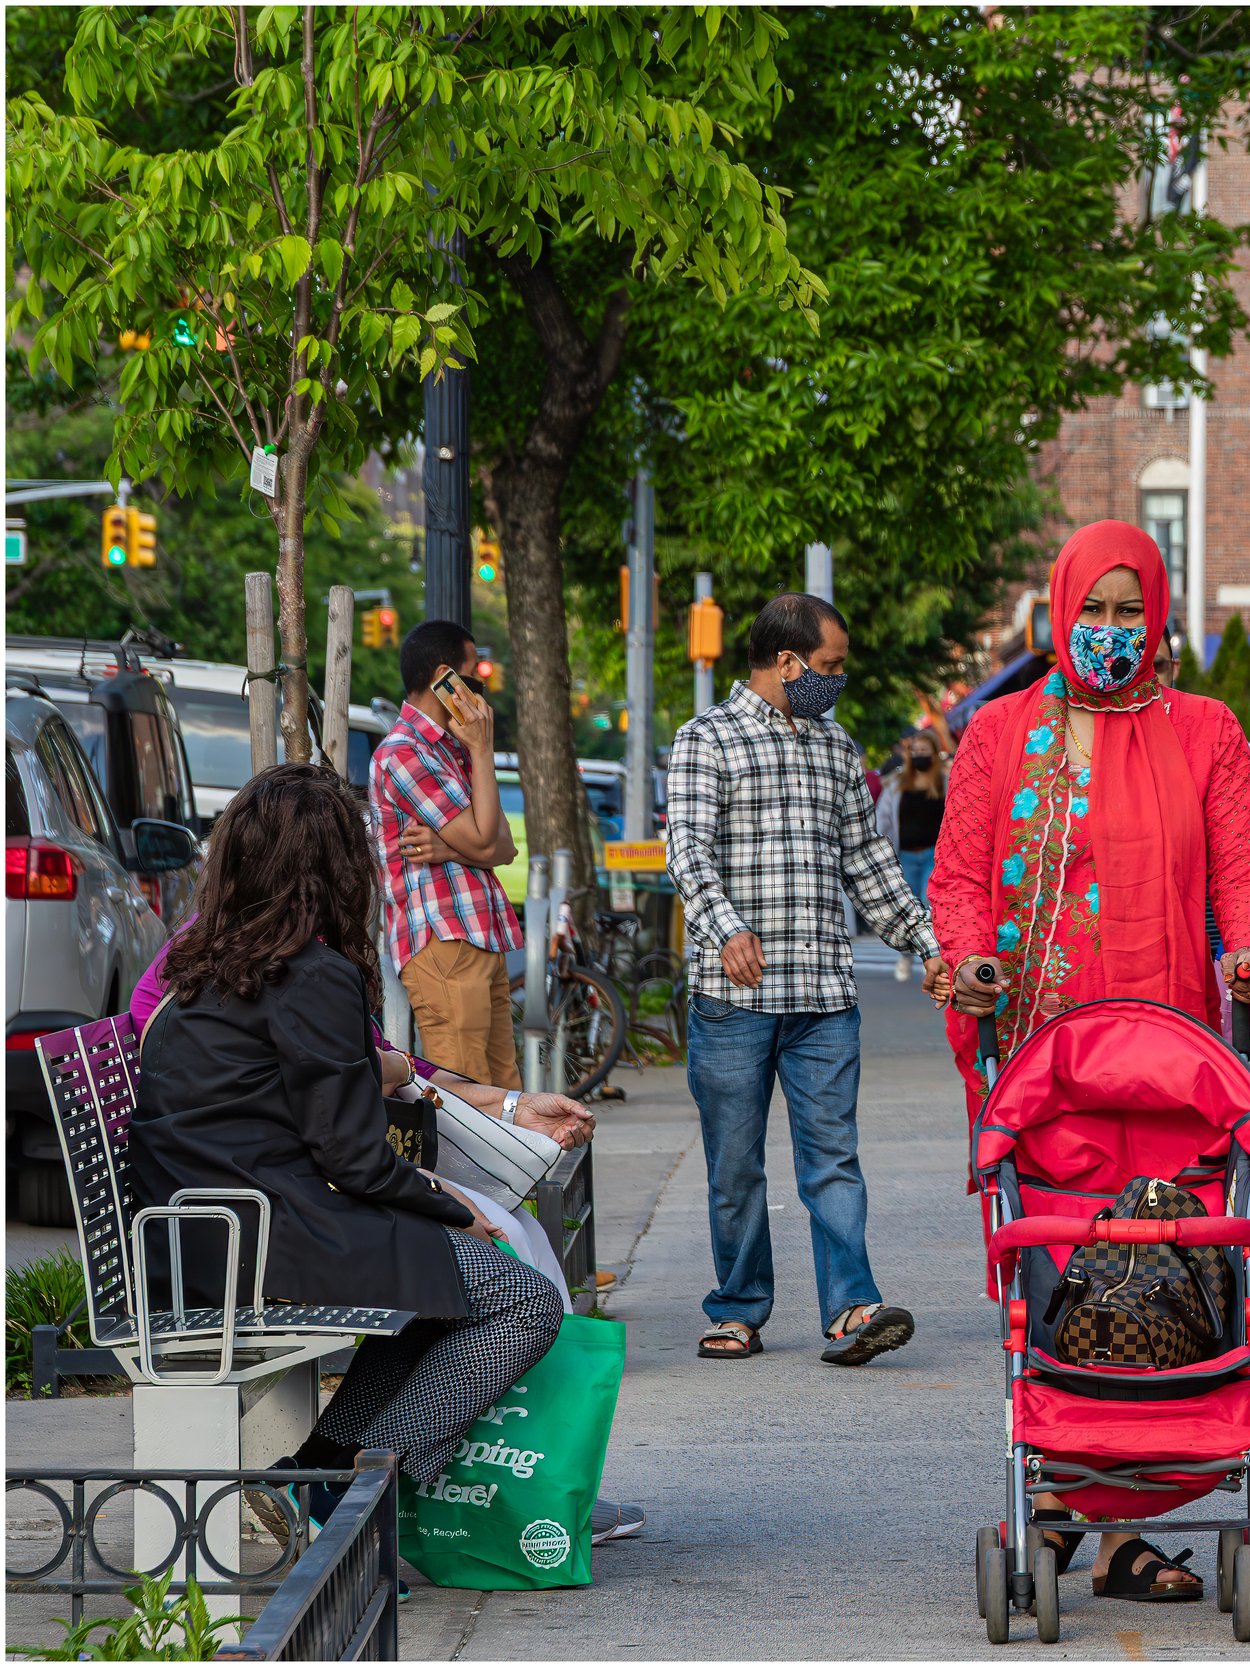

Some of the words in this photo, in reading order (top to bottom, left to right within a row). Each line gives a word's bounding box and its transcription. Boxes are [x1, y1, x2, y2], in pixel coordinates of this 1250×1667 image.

[477, 1406, 529, 1426] or
[450, 1438, 545, 1479] pping
[411, 1473, 499, 1509] Here!
[433, 1528, 471, 1538] Recycle.
